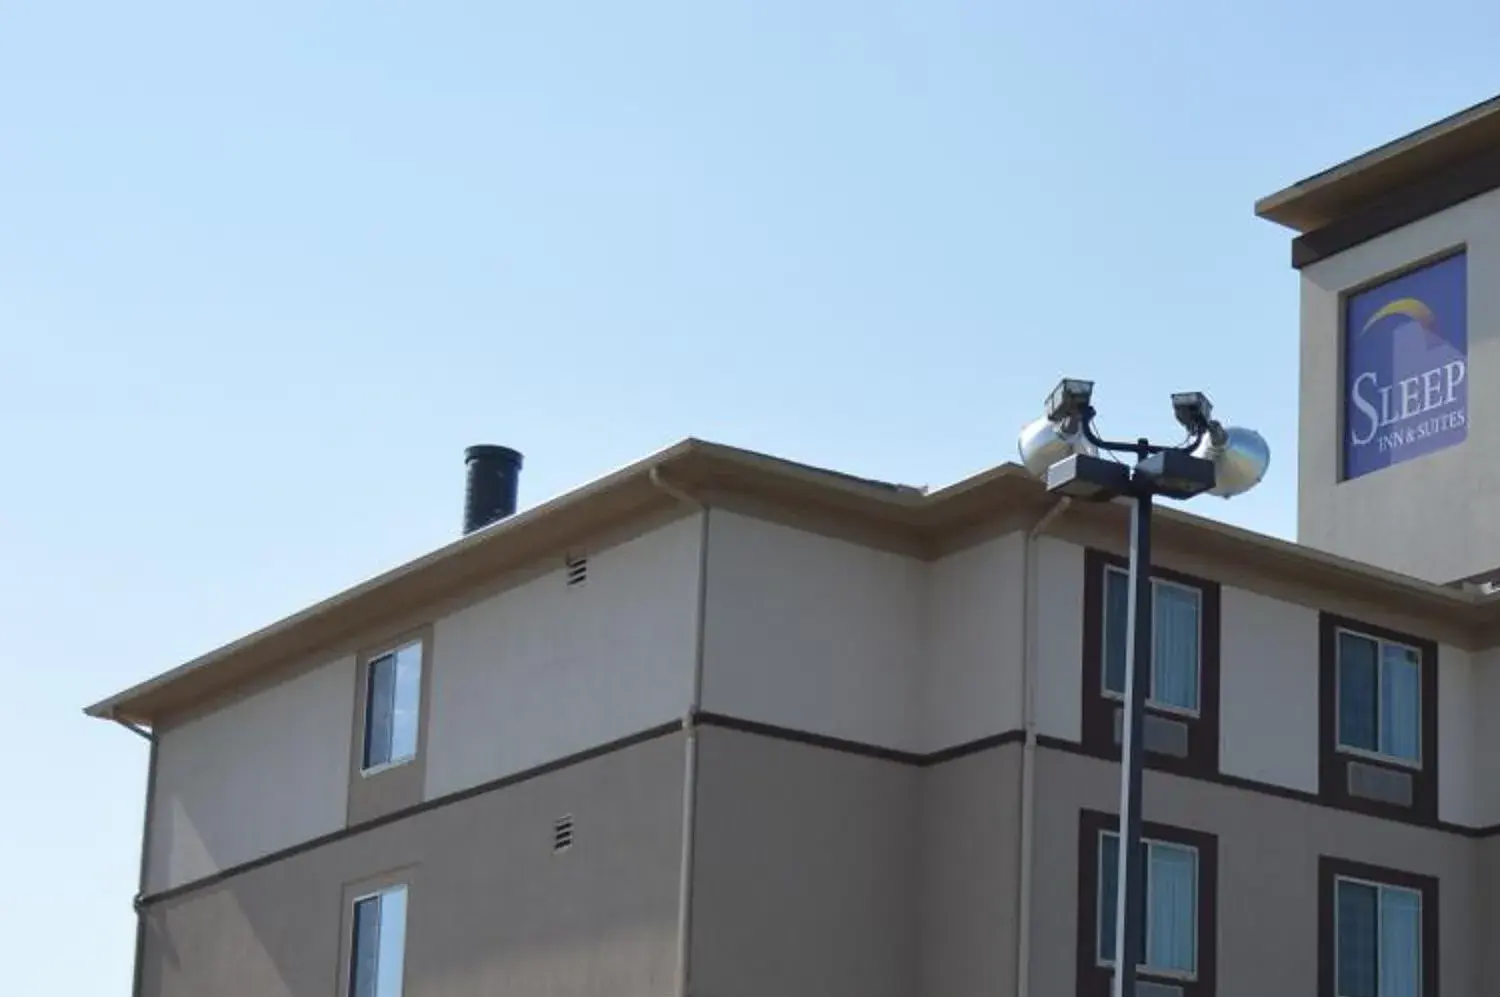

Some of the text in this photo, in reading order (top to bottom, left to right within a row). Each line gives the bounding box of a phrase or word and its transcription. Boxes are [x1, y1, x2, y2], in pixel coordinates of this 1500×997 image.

[1351, 360, 1465, 445] SLEEP
[1378, 409, 1465, 453] INN & SUITES
